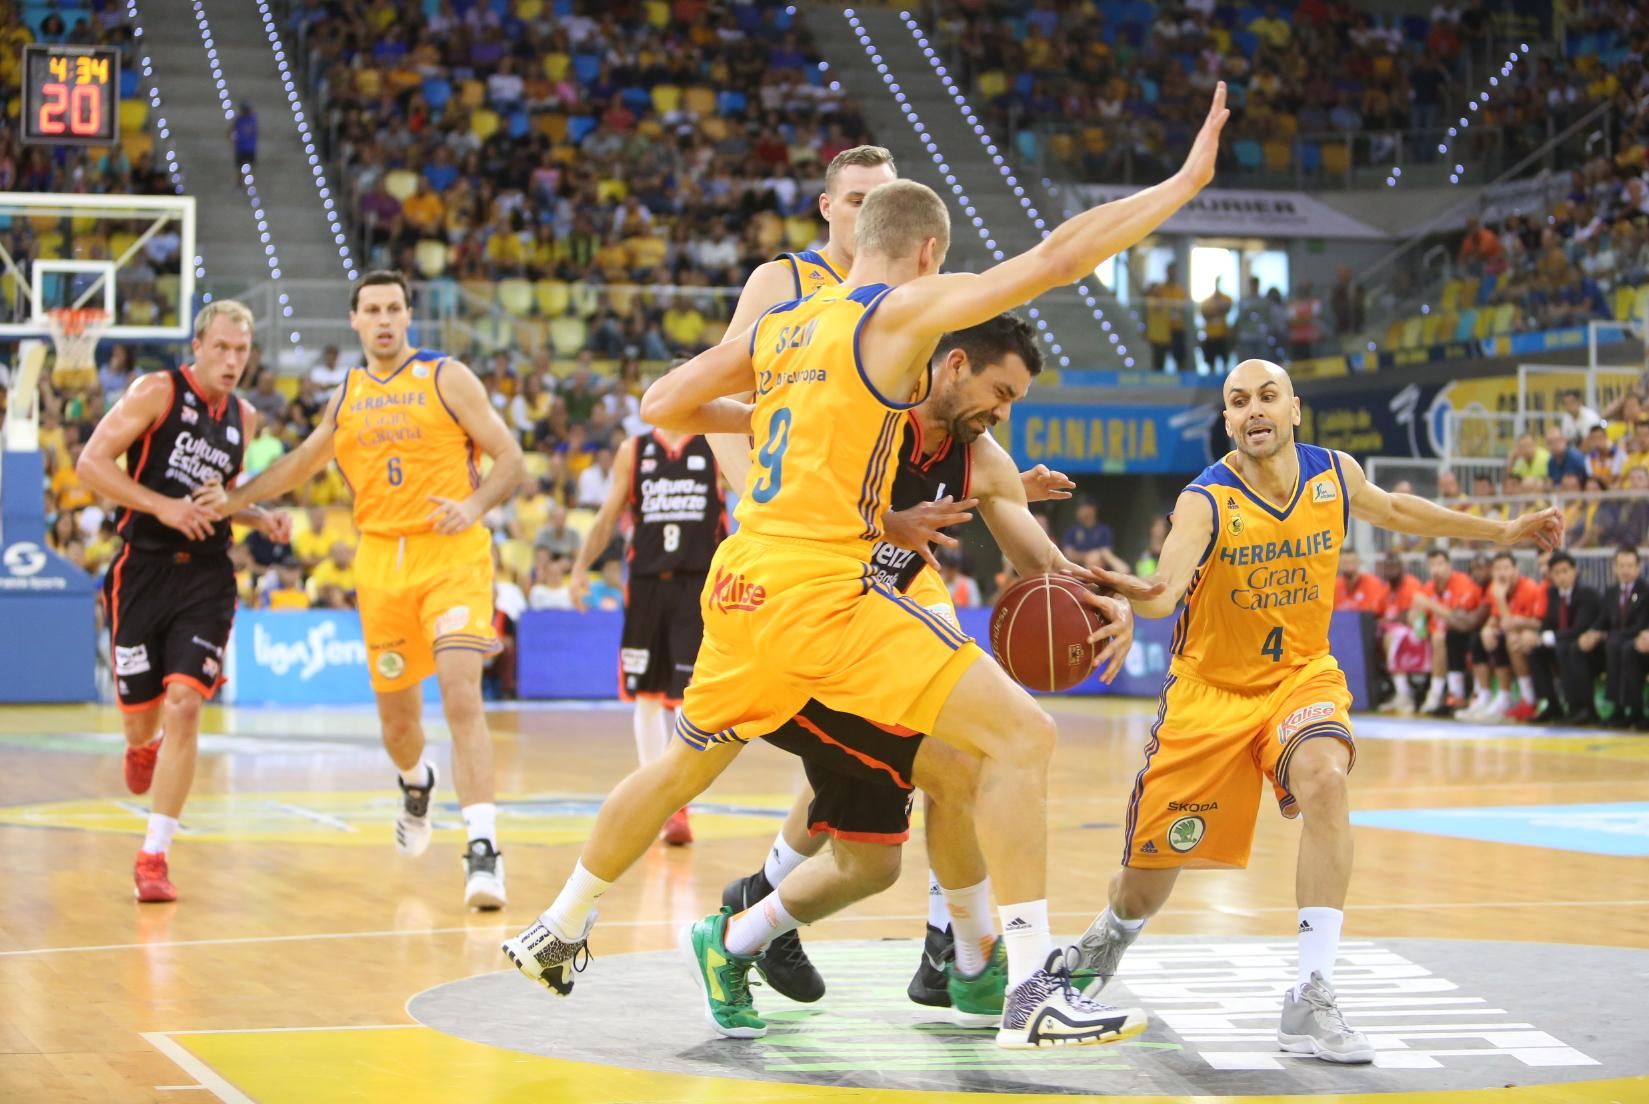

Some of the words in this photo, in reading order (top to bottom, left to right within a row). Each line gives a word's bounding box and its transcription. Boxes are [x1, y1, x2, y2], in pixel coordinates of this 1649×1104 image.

[49, 56, 109, 85] 4:34
[39, 83, 100, 135] 20
[175, 431, 231, 468] Cultura
[1026, 416, 1158, 460] CANARIA
[387, 457, 403, 486] 6
[752, 407, 791, 503] 9
[641, 478, 695, 497] Cultura
[641, 495, 707, 513] Esfuerzo
[663, 524, 680, 552] 8
[1220, 530, 1333, 566] HERBALIFE
[1247, 566, 1307, 590] Gran
[1231, 581, 1319, 611] Canaria
[1261, 626, 1284, 662] 4
[1282, 707, 1334, 743] Kalise
